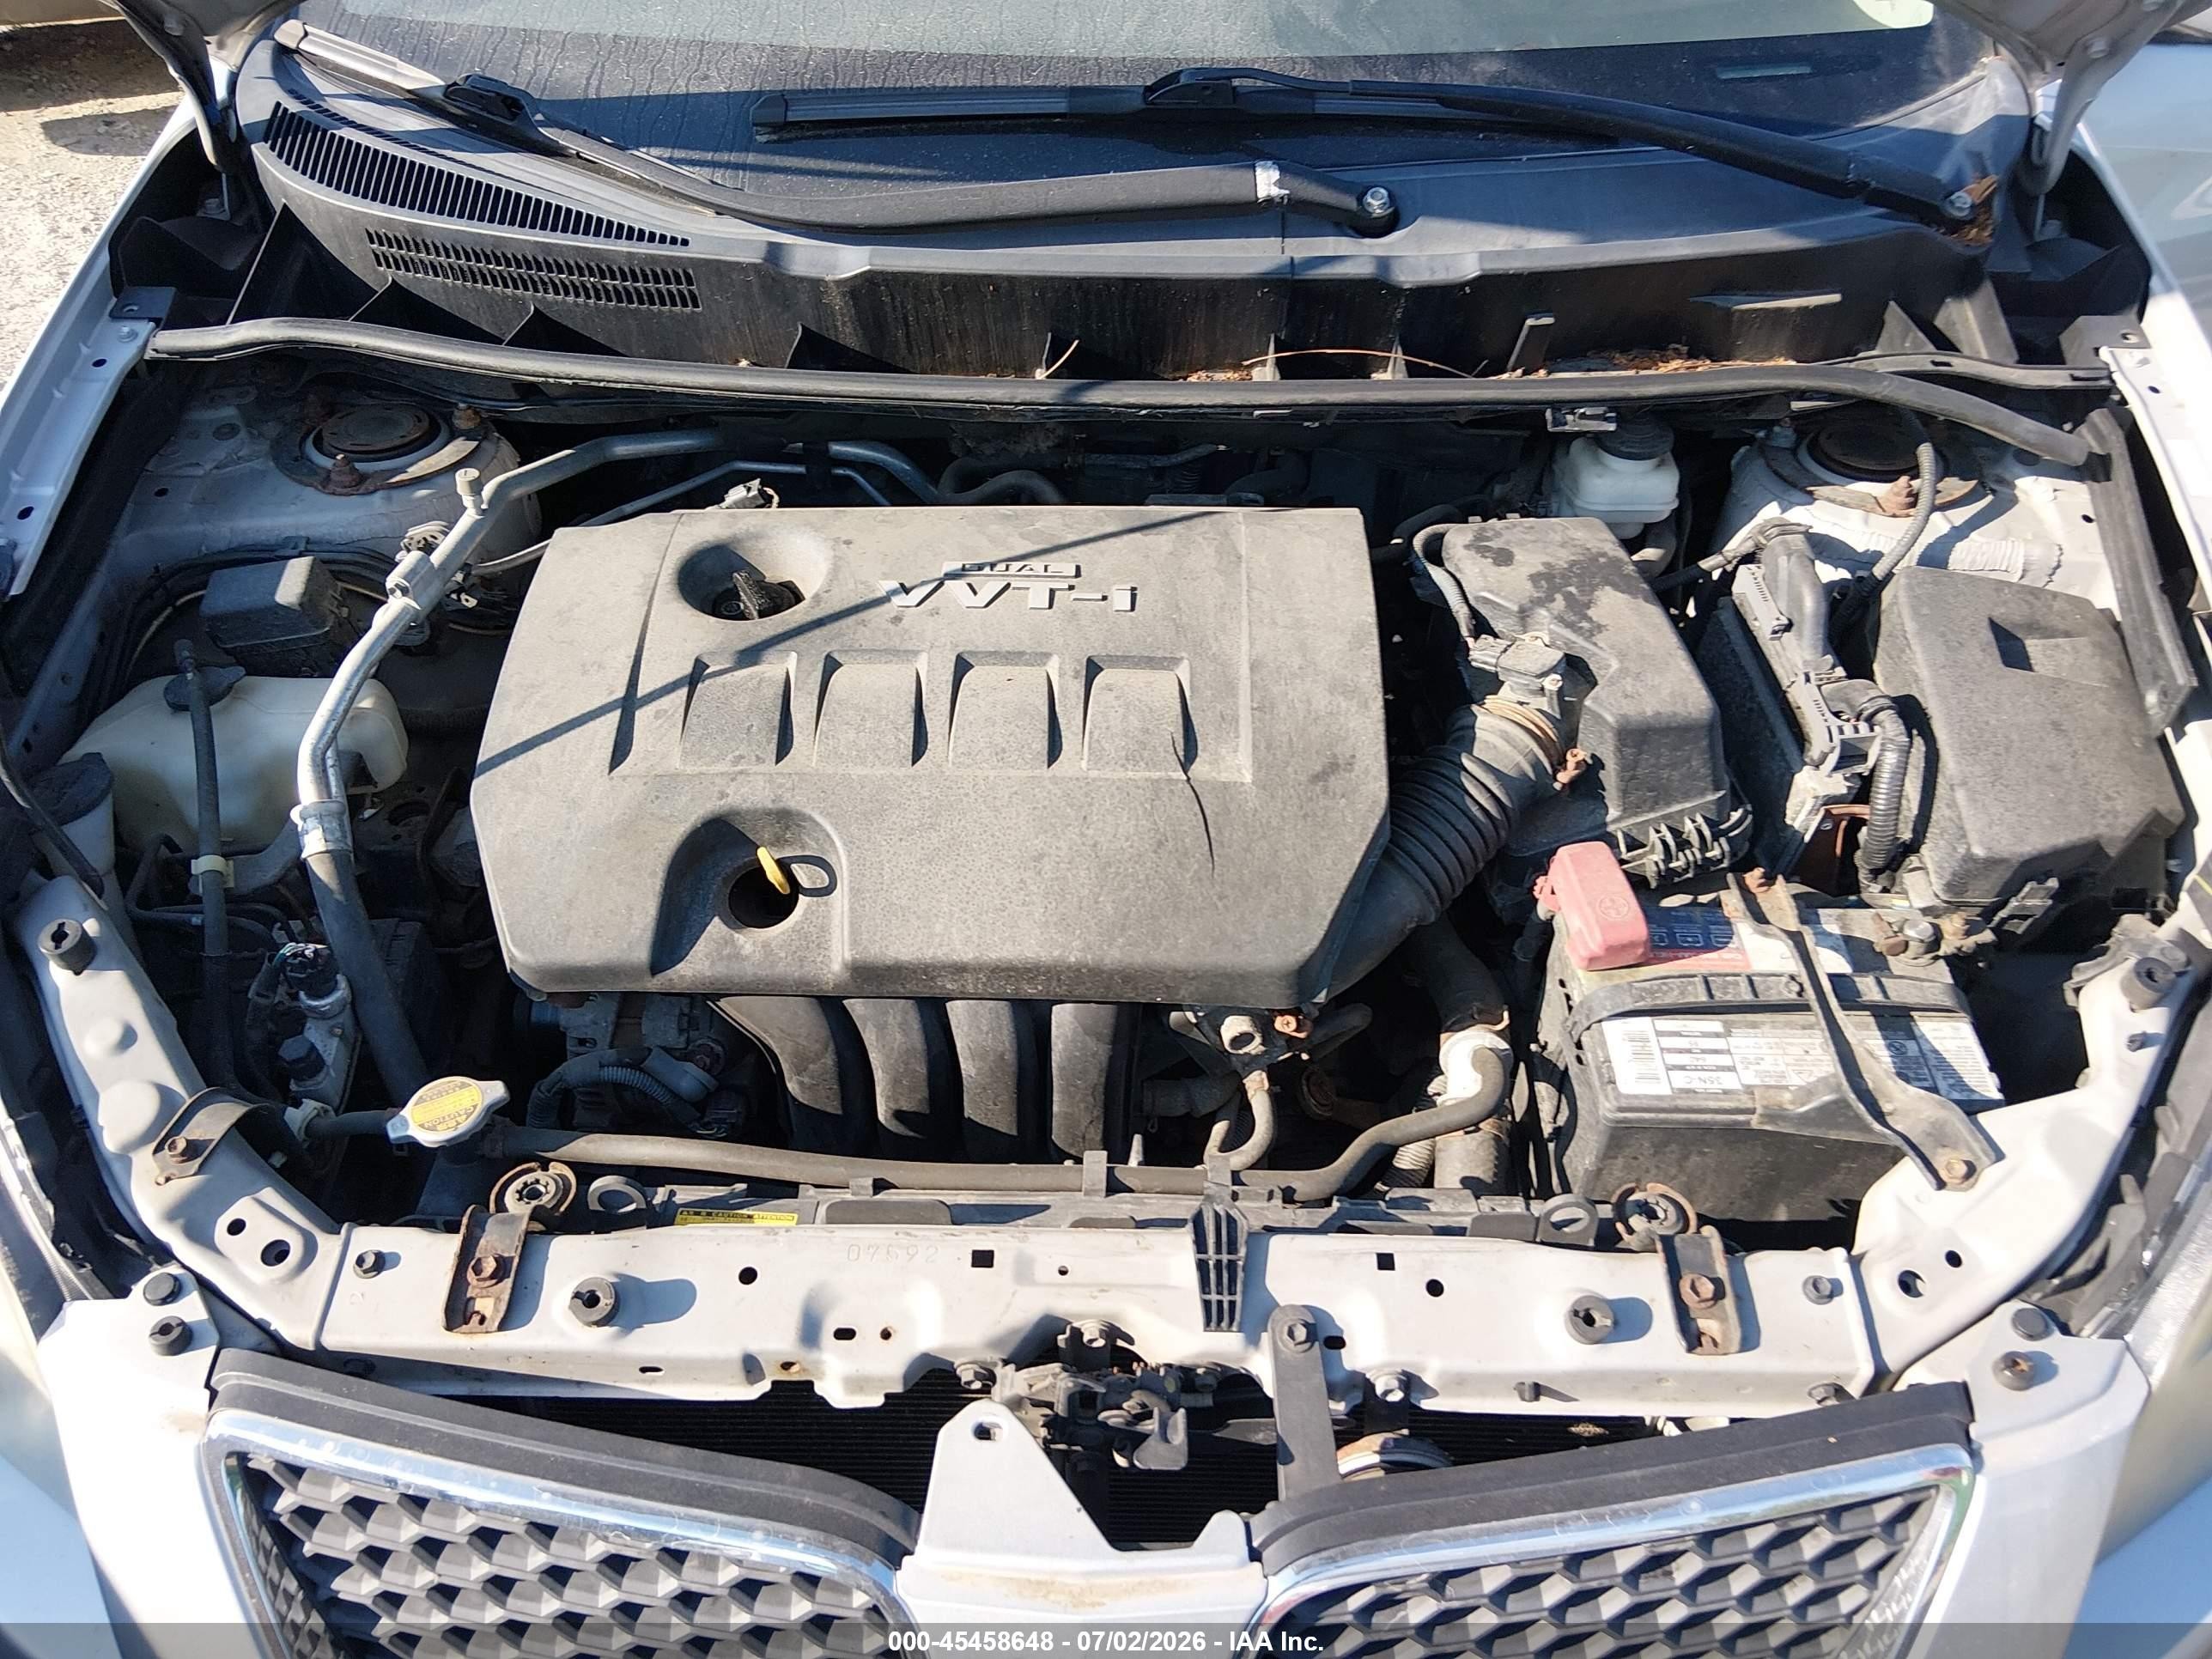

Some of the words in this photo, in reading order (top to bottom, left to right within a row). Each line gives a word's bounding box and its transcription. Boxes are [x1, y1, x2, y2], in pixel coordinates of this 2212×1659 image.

[960, 562, 1066, 574] DUAL
[876, 580, 1138, 613] VVT-i
[423, 1106, 474, 1128] CAUTION
[712, 1211, 748, 1219] CAUTION
[753, 1213, 795, 1222] ATTENTION
[847, 1243, 939, 1263] 07592
